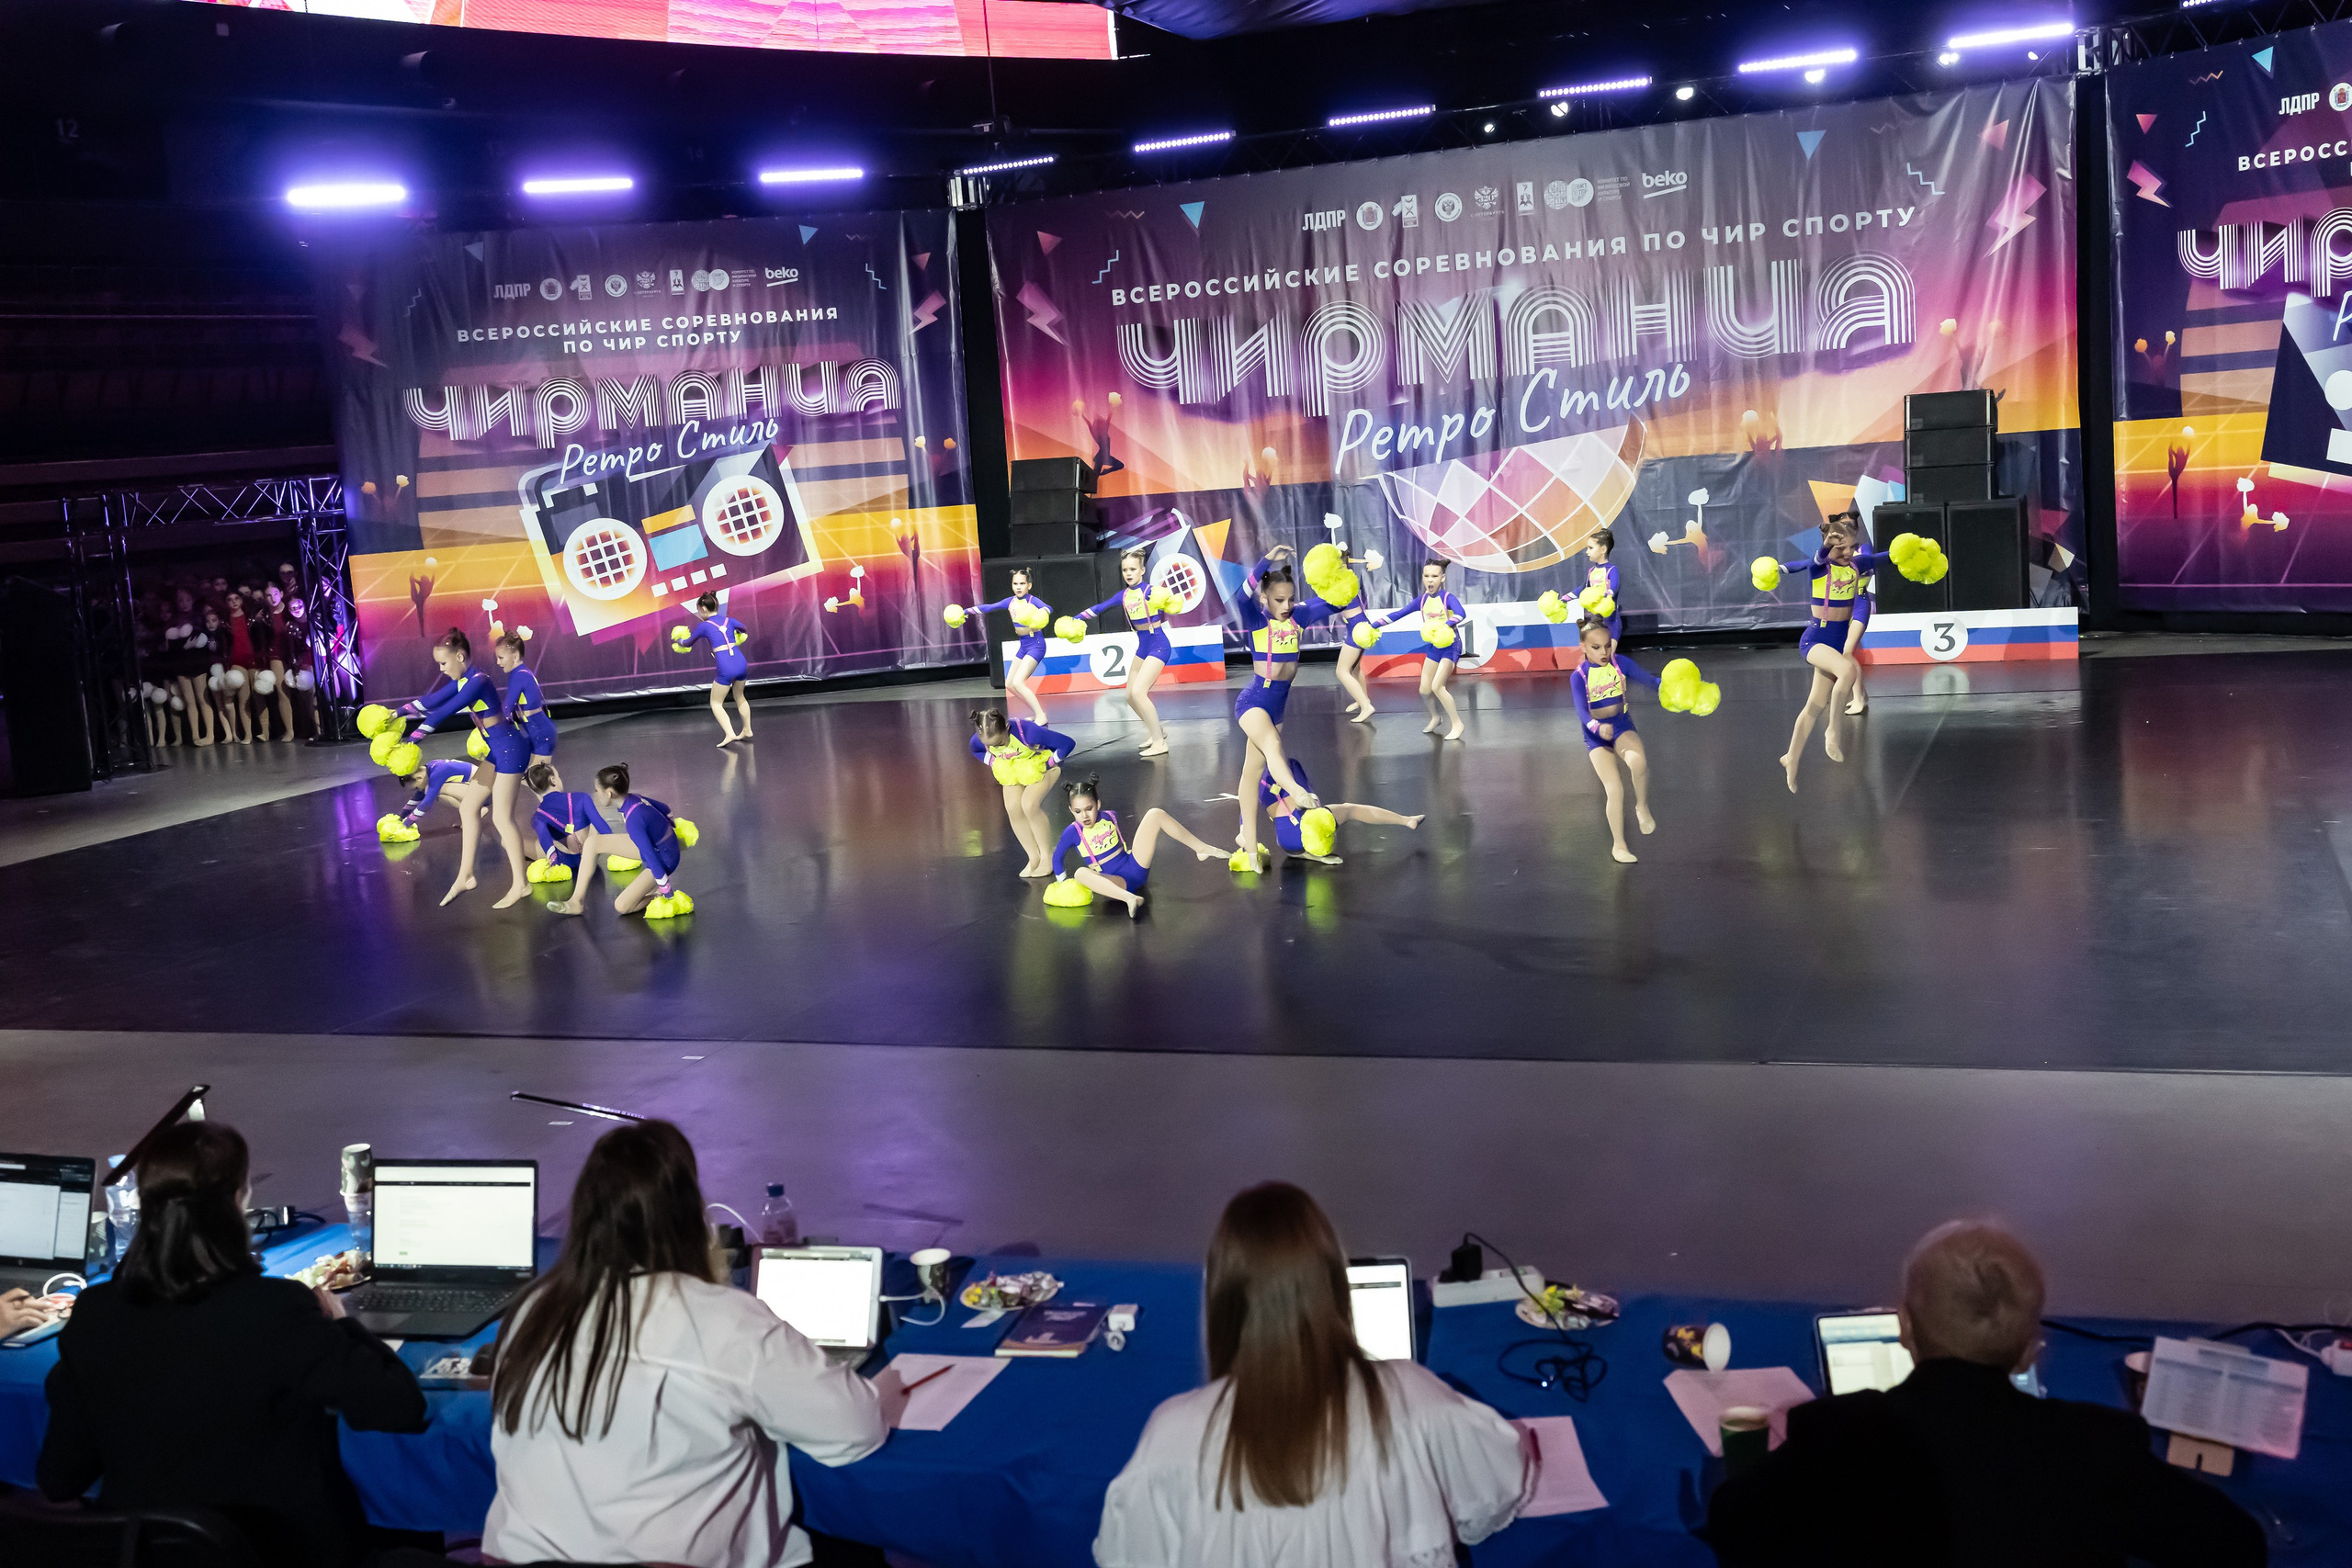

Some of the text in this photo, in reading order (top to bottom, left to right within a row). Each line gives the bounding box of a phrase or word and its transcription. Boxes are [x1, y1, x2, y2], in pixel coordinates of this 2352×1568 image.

[2278, 92, 2320, 116] ЛДПР
[1642, 170, 1688, 189] beko
[1302, 209, 1346, 231] ЛДПР
[1112, 206, 1916, 306] ВСЕРОССИЙСКИЕ СОРЕВНОВАНИЯ ПО ЧИР СПОРТУ
[764, 266, 799, 279] beko
[493, 283, 531, 300] ЛДПР
[457, 307, 839, 343] ВСЕРОССИЙСКИЕ СОРЕВНОВАНИЯ
[563, 330, 741, 354] ПО ЧИР СПОРТУ
[1335, 363, 1690, 474] Ретро Стиль
[559, 417, 779, 484] Ретро Стиль
[1458, 620, 1480, 658] 1
[1933, 623, 1956, 652] 3
[1102, 645, 1126, 678] 2
